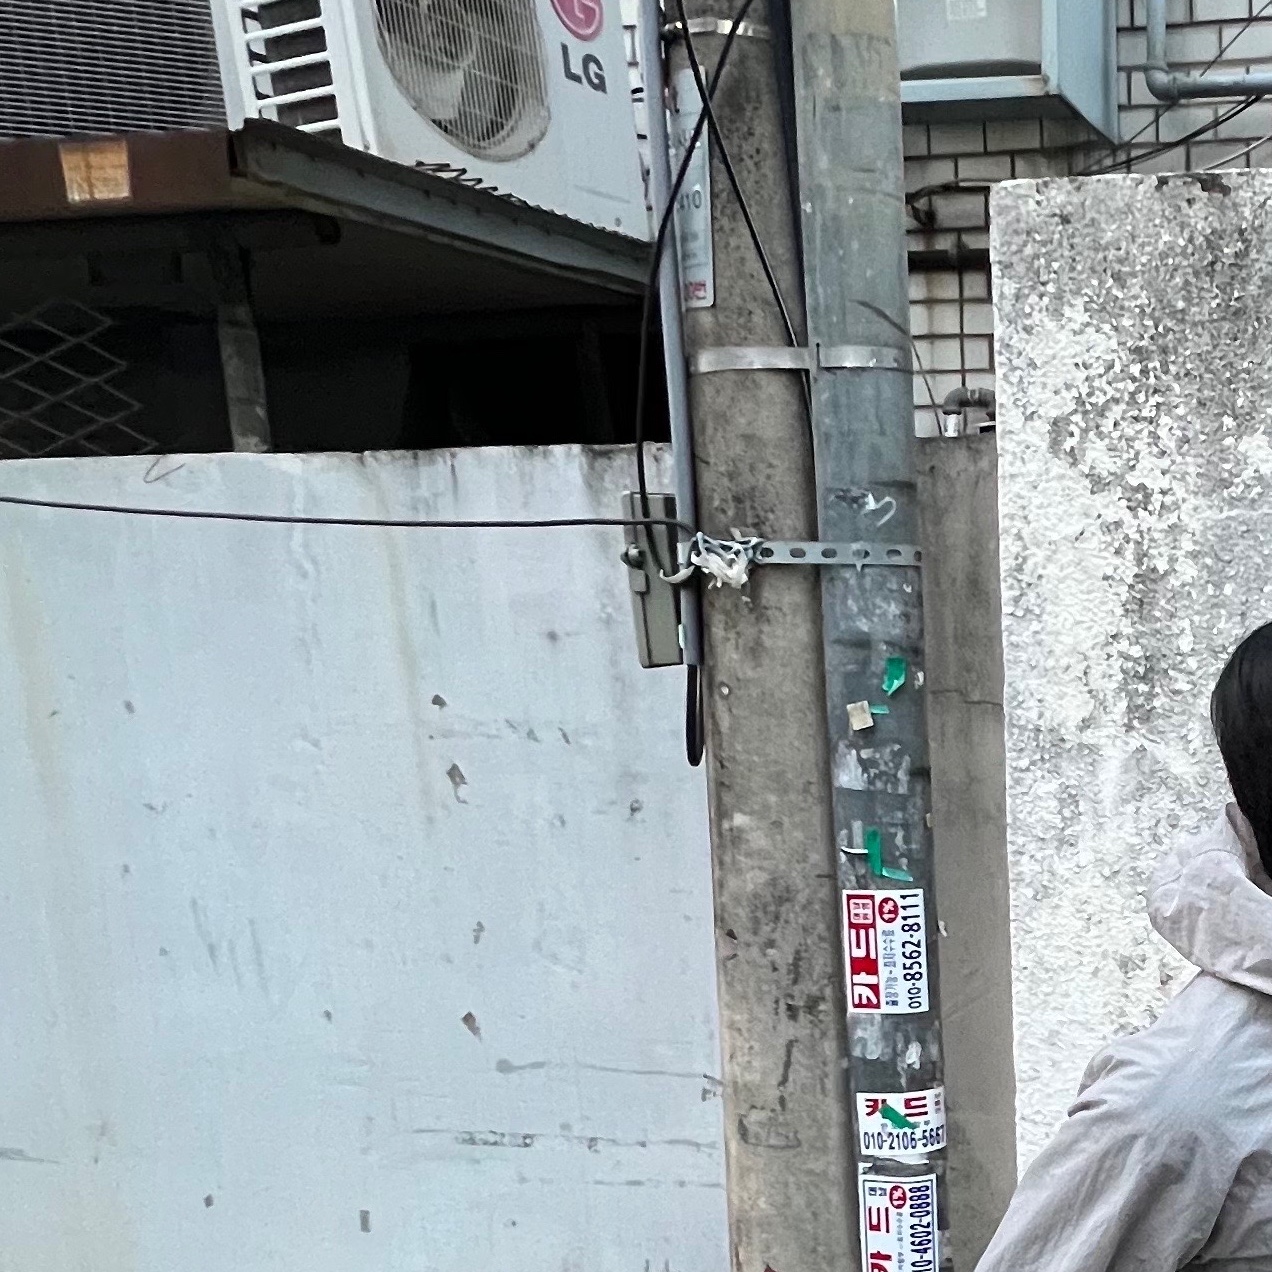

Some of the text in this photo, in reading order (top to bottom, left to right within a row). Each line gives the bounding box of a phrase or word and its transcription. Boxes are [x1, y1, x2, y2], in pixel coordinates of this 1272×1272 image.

[561, 42, 607, 94] LG
[850, 927, 878, 1005] 카드
[900, 893, 923, 1009] 010-8562-8111
